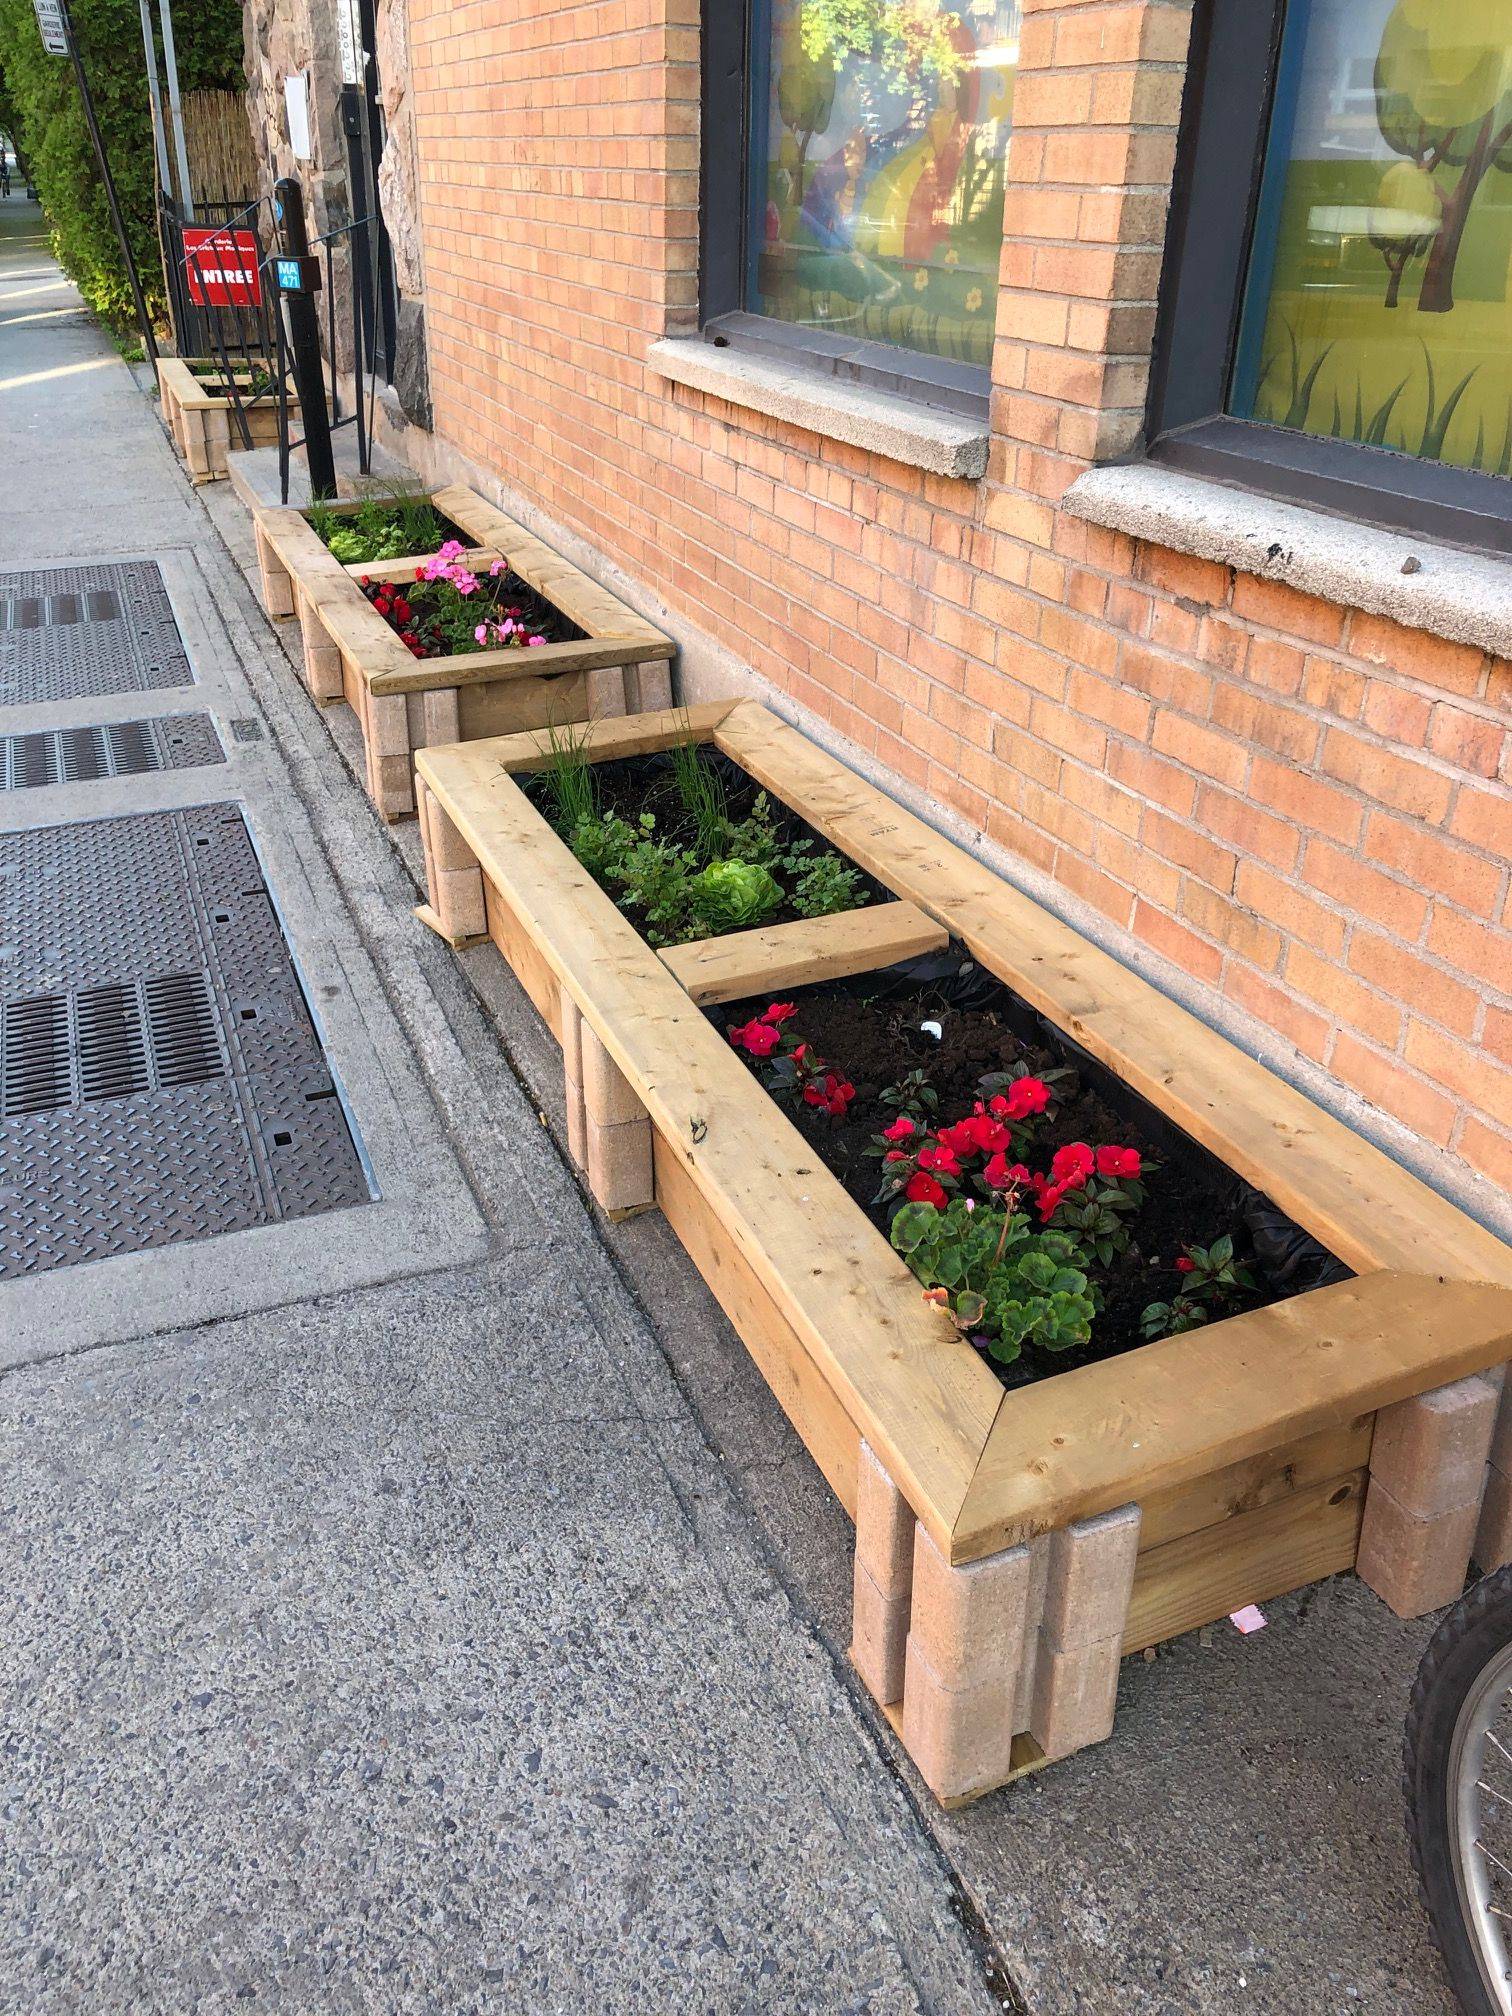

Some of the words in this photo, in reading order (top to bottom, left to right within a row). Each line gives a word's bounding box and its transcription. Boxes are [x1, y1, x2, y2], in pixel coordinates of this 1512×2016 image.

[224, 244, 255, 252] Maiques
[279, 262, 297, 275] MA
[281, 275, 298, 287] 471
